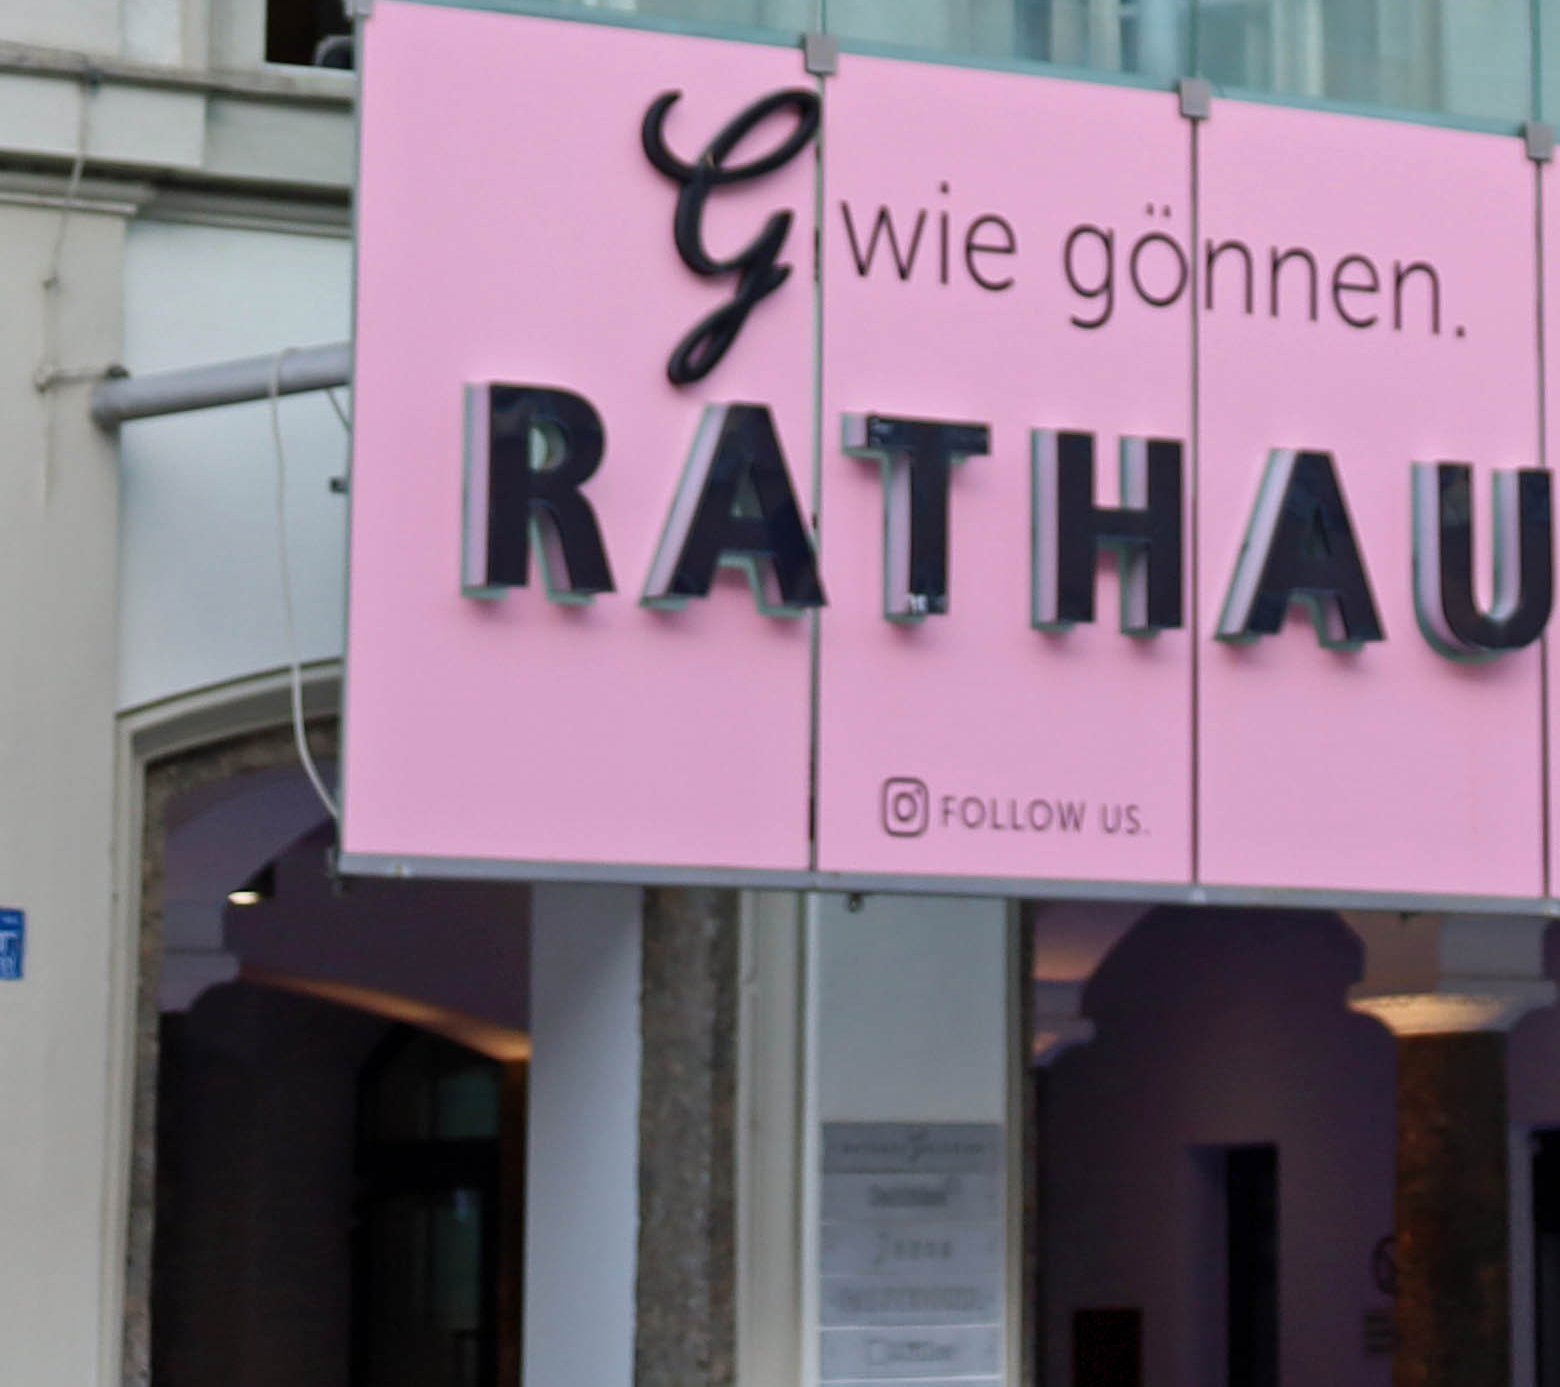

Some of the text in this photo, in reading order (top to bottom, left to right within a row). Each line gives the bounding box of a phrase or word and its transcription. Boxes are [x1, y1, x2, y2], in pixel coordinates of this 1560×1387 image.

[641, 89, 1467, 387] G wie gönnen.
[941, 794, 1151, 836] FOLLOW US.
